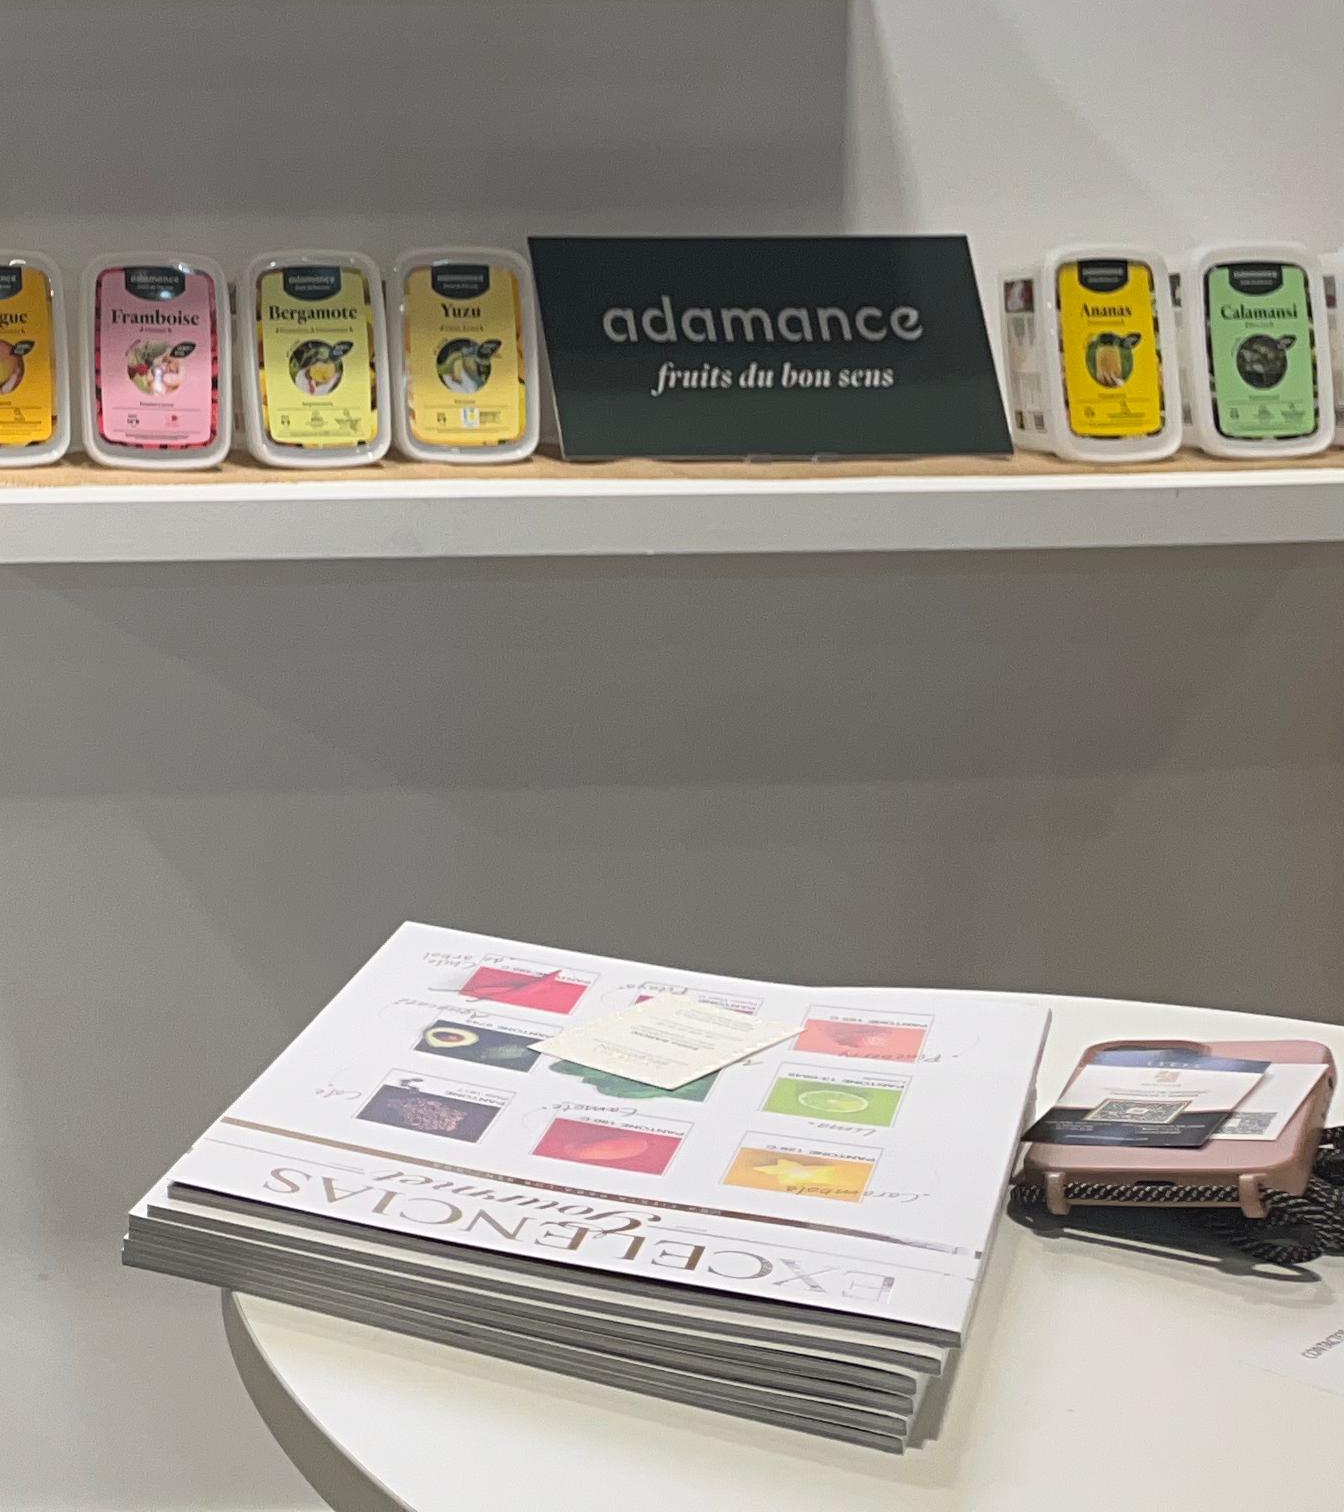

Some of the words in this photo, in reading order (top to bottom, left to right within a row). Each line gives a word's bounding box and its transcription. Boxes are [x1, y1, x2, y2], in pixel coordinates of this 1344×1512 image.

[112, 308, 200, 327] Framboise
[268, 303, 358, 324] Bergamote
[439, 302, 482, 318] Yuzu
[602, 294, 925, 344] adamance
[1080, 302, 1132, 319] Ananas
[1220, 302, 1298, 321] Calamansi
[650, 360, 733, 398] fruits
[739, 361, 775, 389] du
[781, 361, 832, 389] bon
[838, 367, 895, 389] sens
[446, 1090, 506, 1106] PANTONE
[621, 1123, 685, 1137] PANTONE
[809, 1149, 876, 1163] PANTONE
[367, 1170, 662, 1240] Gourmet
[264, 1165, 897, 1304] EXCELENCIAS
